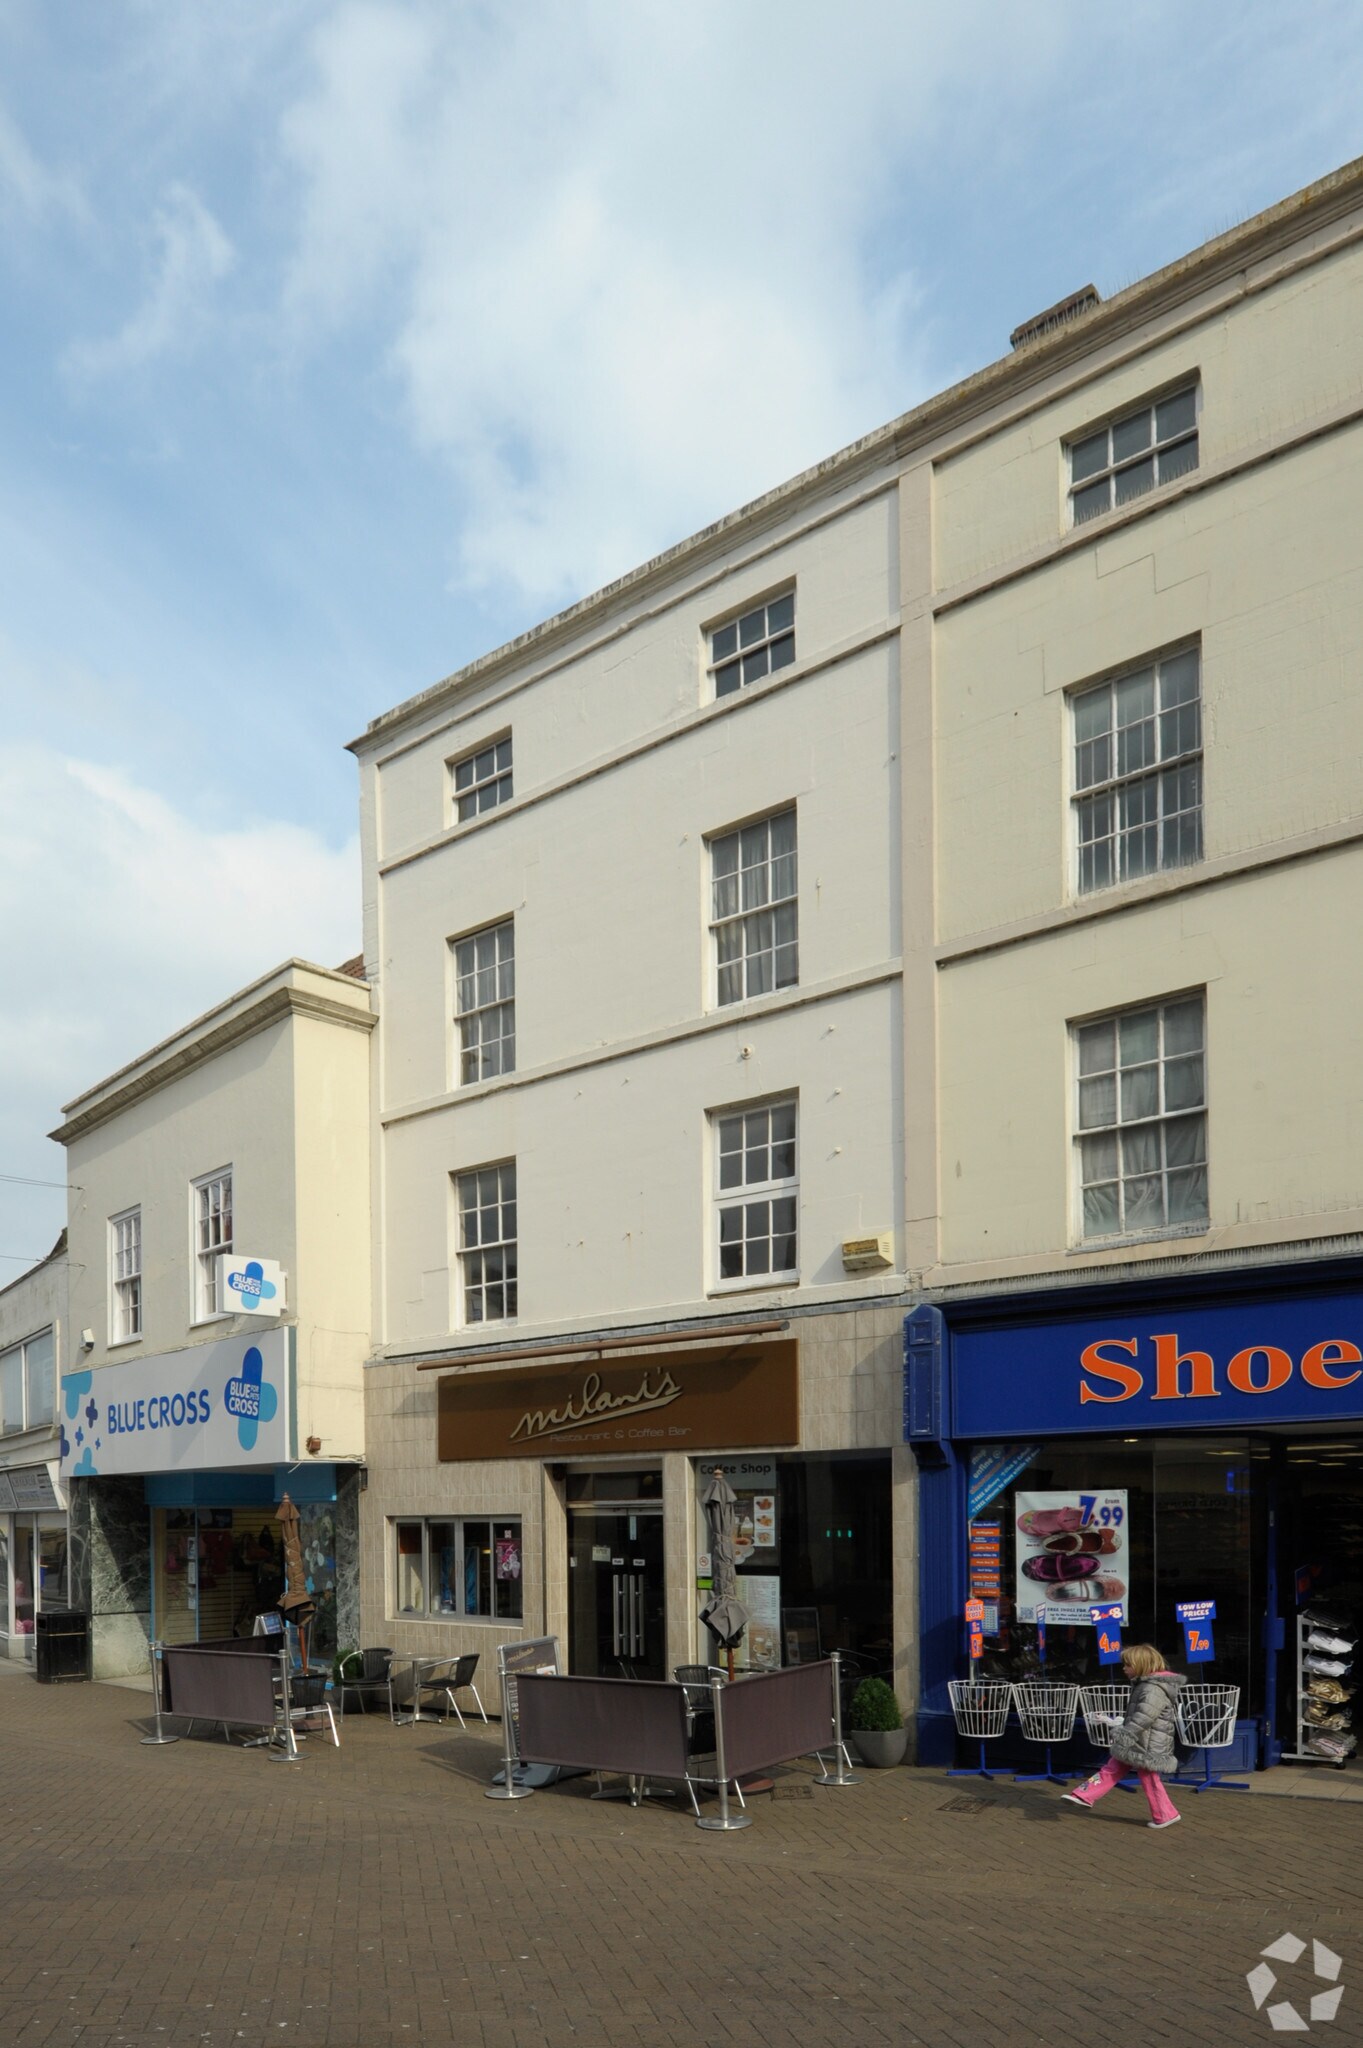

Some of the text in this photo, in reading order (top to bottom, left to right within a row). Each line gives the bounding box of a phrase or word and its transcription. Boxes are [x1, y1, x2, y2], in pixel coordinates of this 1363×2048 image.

[233, 1273, 253, 1285] BLUE
[232, 1281, 260, 1295] CROSS
[1080, 1333, 1363, 1405] Shoe
[229, 1381, 250, 1399] BLUE
[107, 1389, 211, 1434] BLUE CROSS
[228, 1396, 259, 1417] CROSS
[614, 1429, 624, 1439] &
[628, 1428, 664, 1439] Coffee
[668, 1426, 692, 1437] Bar
[741, 1463, 772, 1475] Shop
[1079, 1495, 1124, 1527] 7.99
[1091, 1609, 1102, 1621] 2
[1178, 1603, 1196, 1611] LOW
[1183, 1609, 1209, 1617] PRICES
[1099, 1632, 1120, 1653] 4.99
[1188, 1630, 1209, 1651] 7.99
